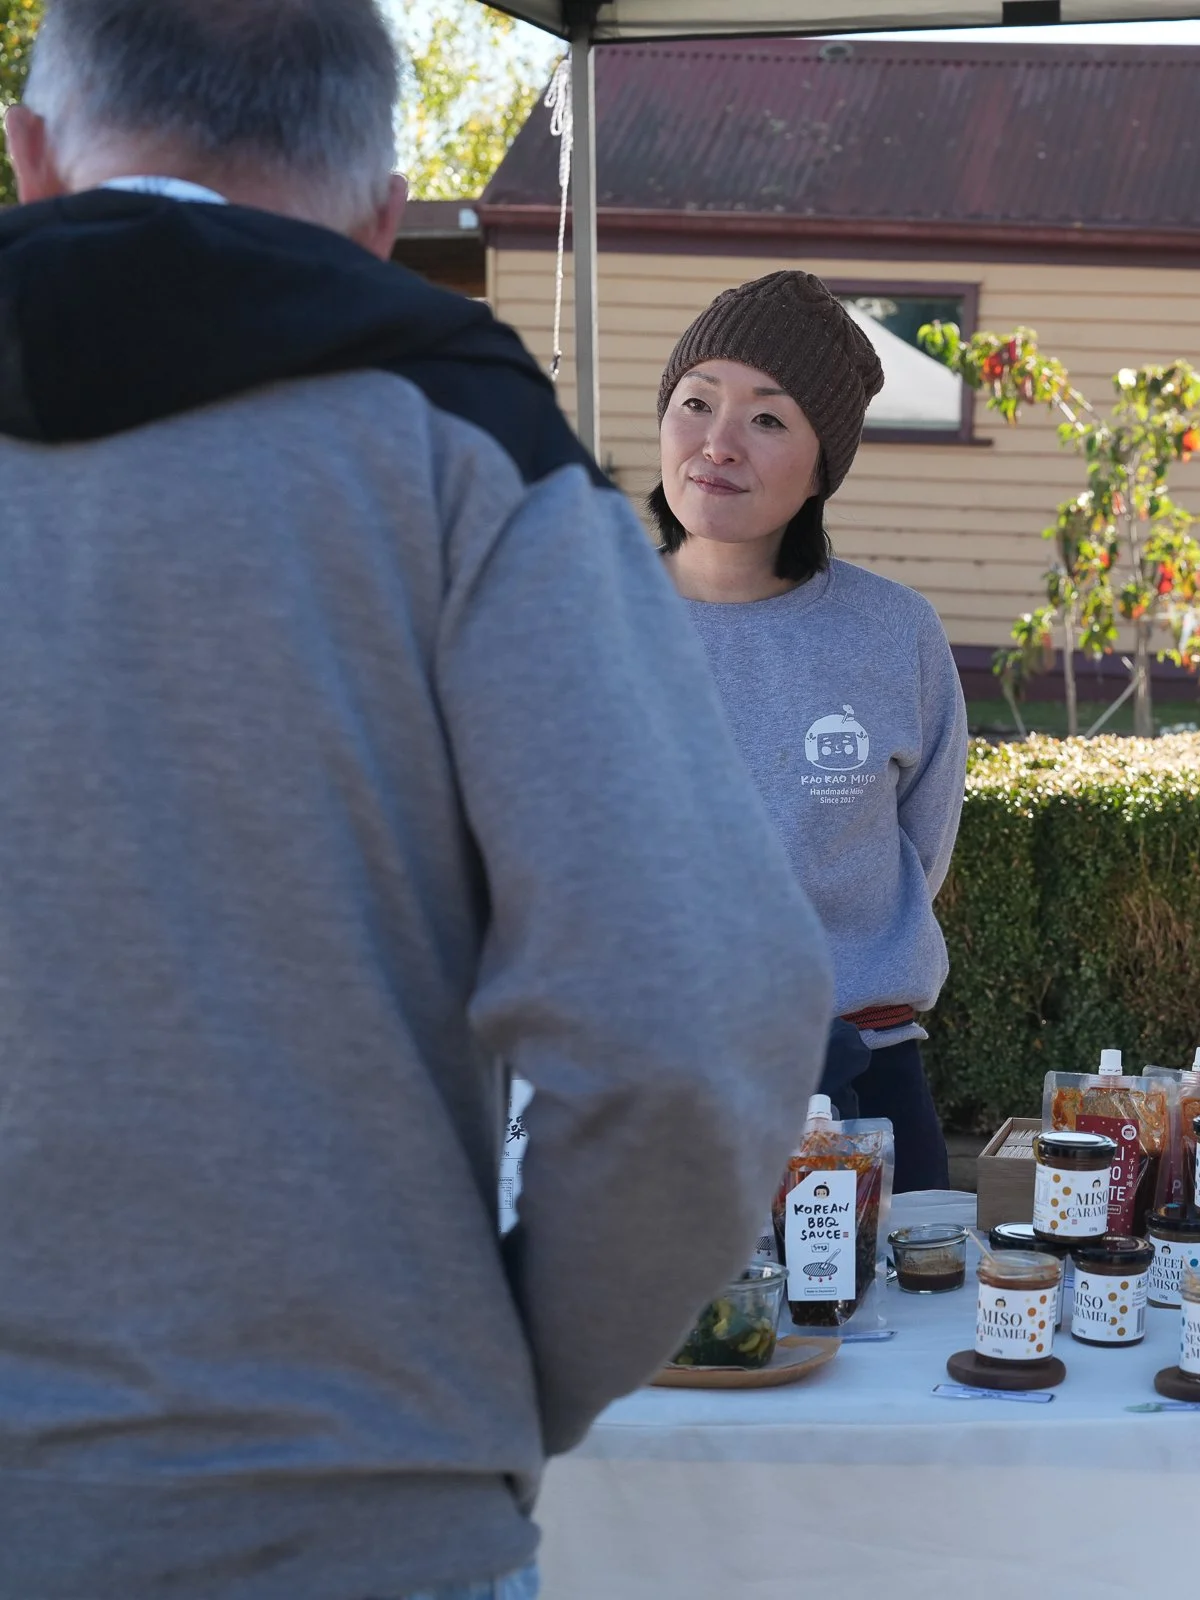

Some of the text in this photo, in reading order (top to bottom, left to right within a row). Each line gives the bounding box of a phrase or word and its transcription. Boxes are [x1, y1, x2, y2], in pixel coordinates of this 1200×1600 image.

[800, 774, 876, 785] KAO KAO MISO
[810, 787, 864, 796] Handmade Miso
[820, 796, 855, 804] Since 2017
[1076, 1190, 1108, 1206] MISO
[793, 1202, 850, 1216] KOREAN
[1066, 1205, 1107, 1218] CARAM
[808, 1216, 839, 1229] BBQ
[800, 1229, 841, 1241] SAUCE
[1150, 1266, 1180, 1281] SESAM
[1152, 1278, 1179, 1291] MISO
[982, 1308, 1022, 1327] MISO
